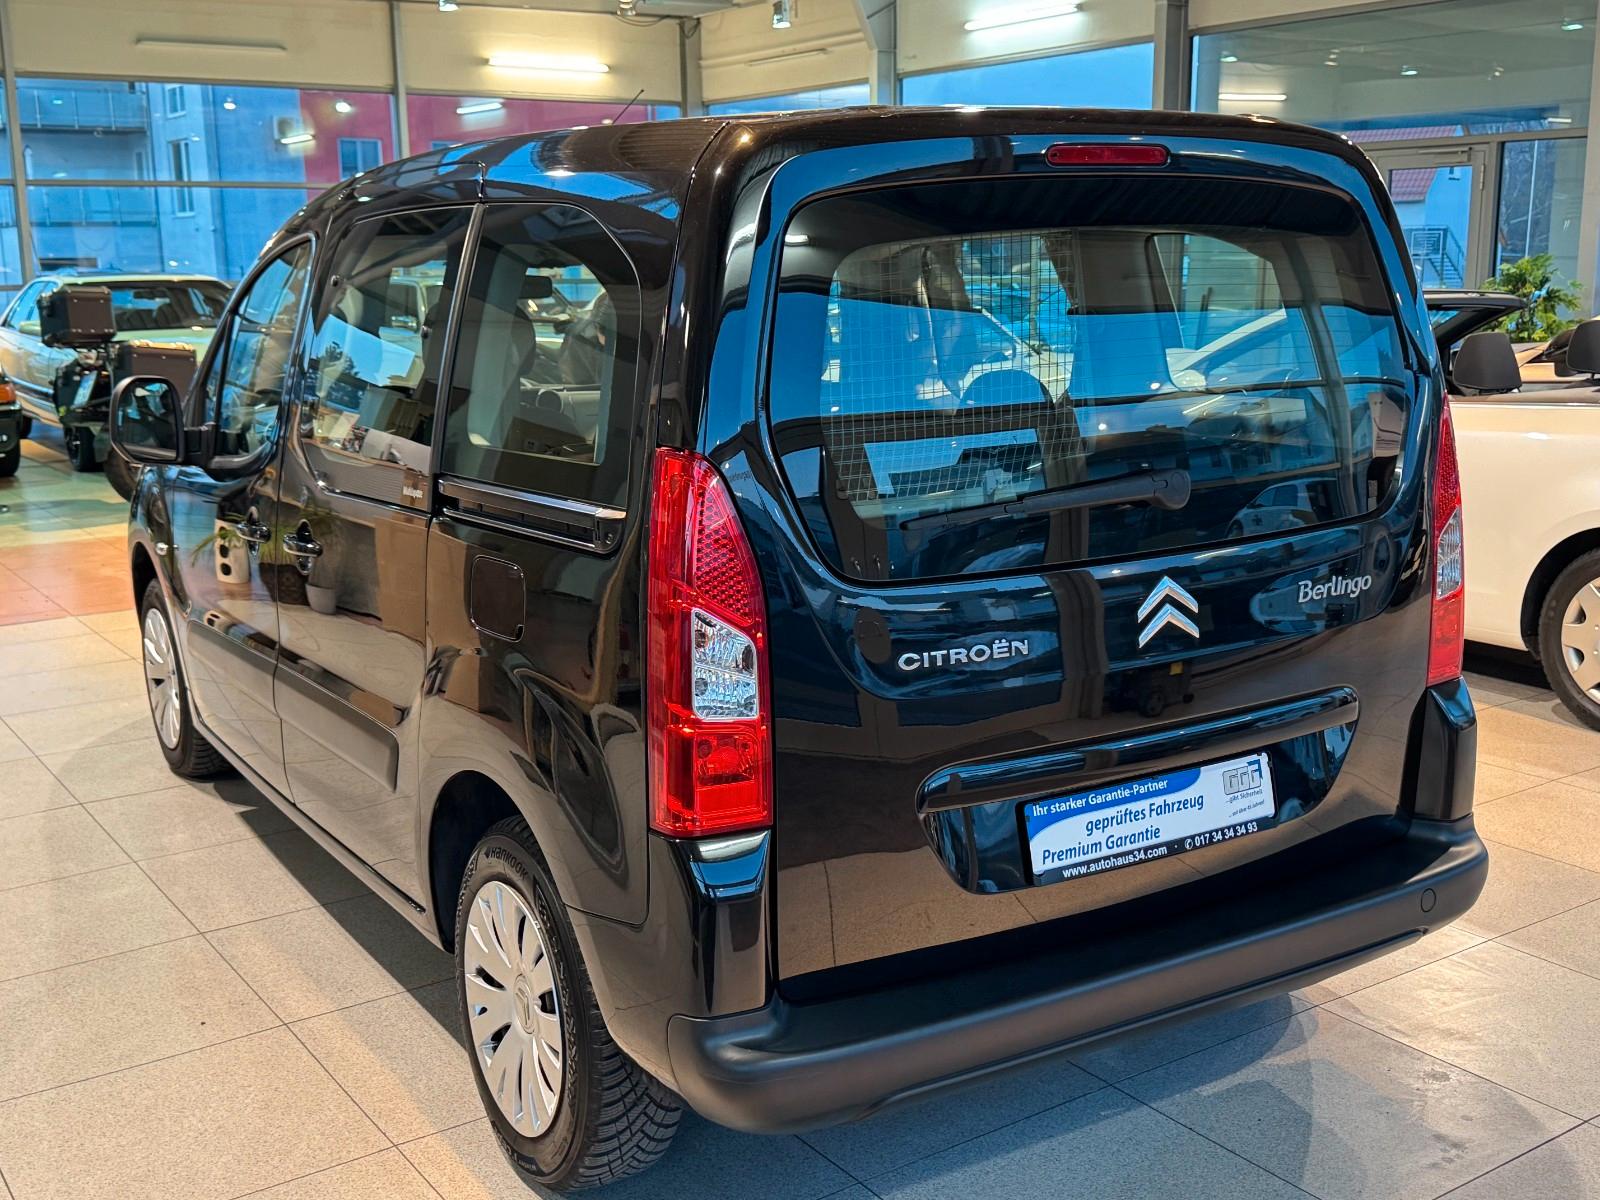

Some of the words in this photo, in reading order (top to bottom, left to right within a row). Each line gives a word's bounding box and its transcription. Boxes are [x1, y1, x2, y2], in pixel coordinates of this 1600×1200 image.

[1298, 573, 1372, 604] Berlingo
[898, 637, 1030, 671] CITROËN
[1033, 804, 1049, 817] Ihr
[1050, 798, 1087, 814] starker
[1088, 779, 1168, 805] Garantie-Partner
[1085, 807, 1146, 837] geprüftes
[1149, 794, 1204, 818] Fahrzeug
[1042, 841, 1102, 865] Premium
[1106, 825, 1161, 850] Garantie
[1062, 846, 1168, 879] www.autohaus34.com
[1194, 834, 1210, 847] 017
[1212, 831, 1223, 842] 34
[1224, 828, 1235, 840] 34
[1236, 825, 1247, 836] 34
[1247, 821, 1258, 833] 93
